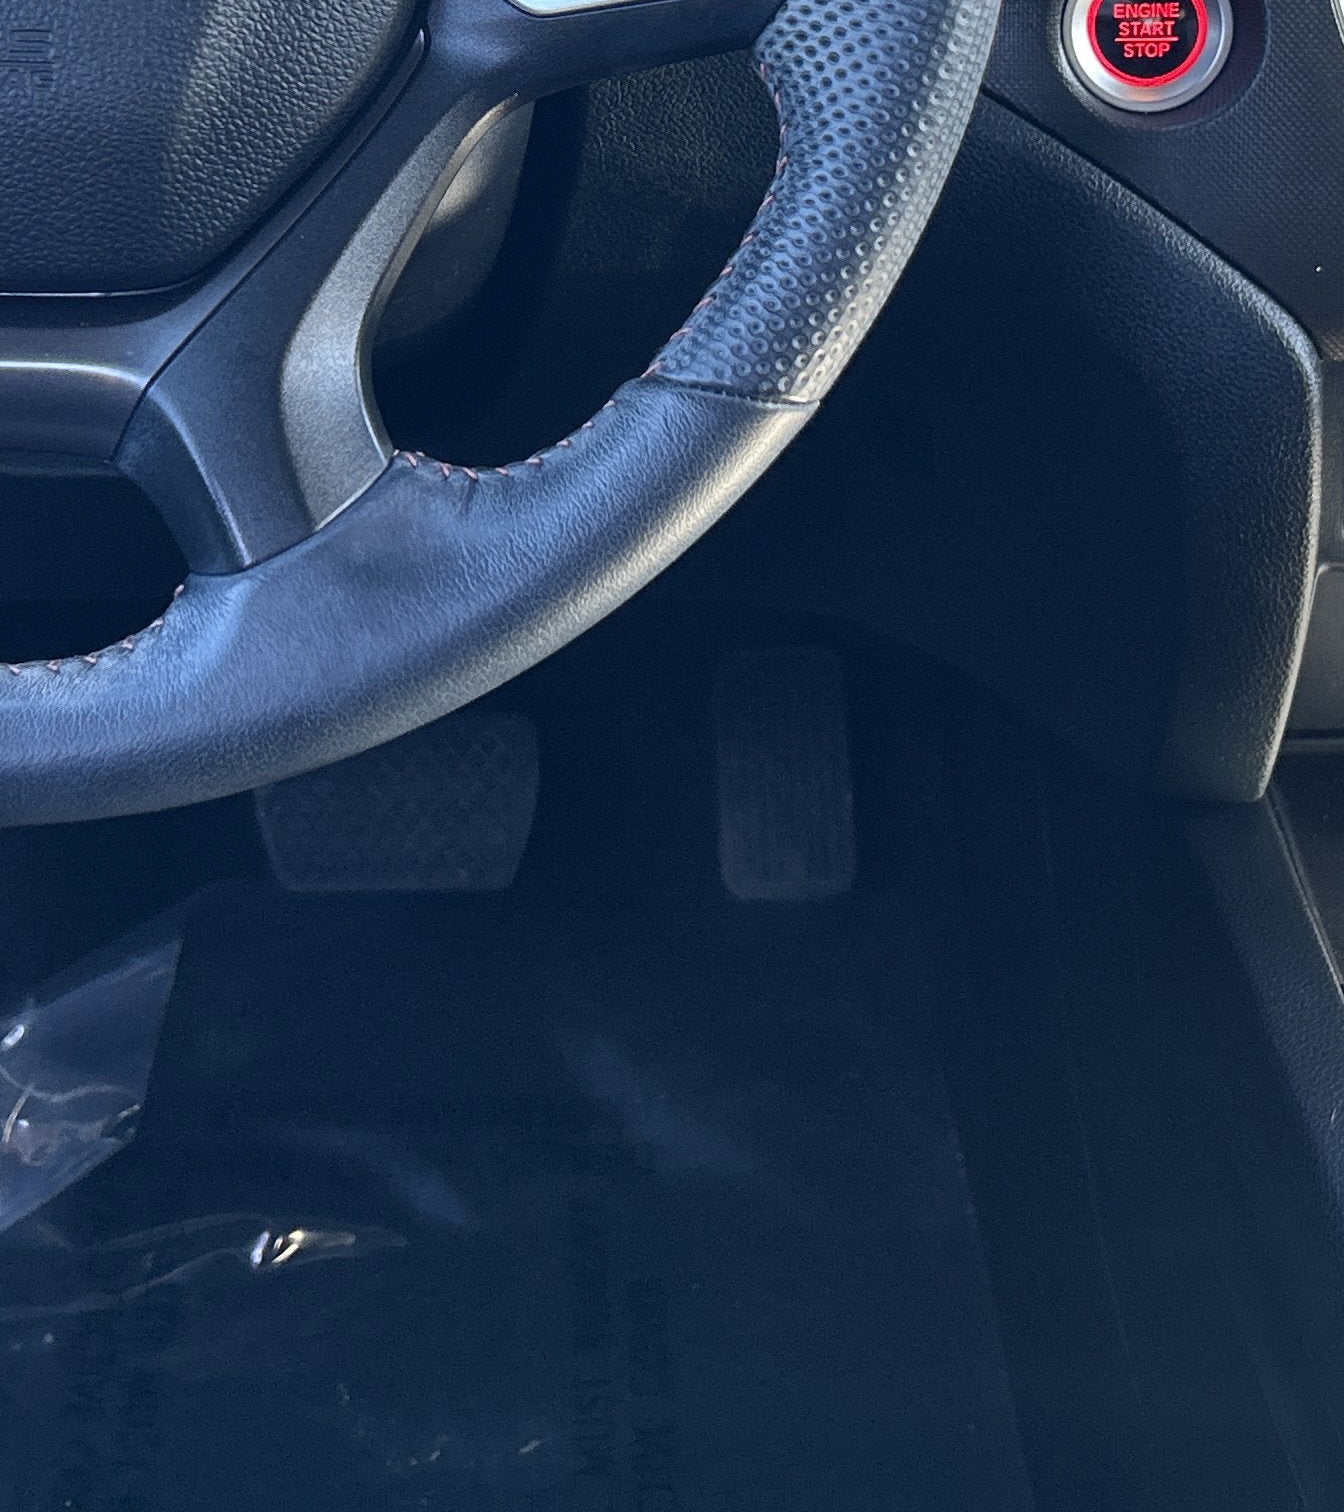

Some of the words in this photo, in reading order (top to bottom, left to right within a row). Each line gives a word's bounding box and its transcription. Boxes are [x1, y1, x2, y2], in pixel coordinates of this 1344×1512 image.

[1113, 2, 1180, 18] ENGINE
[1118, 21, 1175, 36] START
[1123, 42, 1171, 58] STOP
